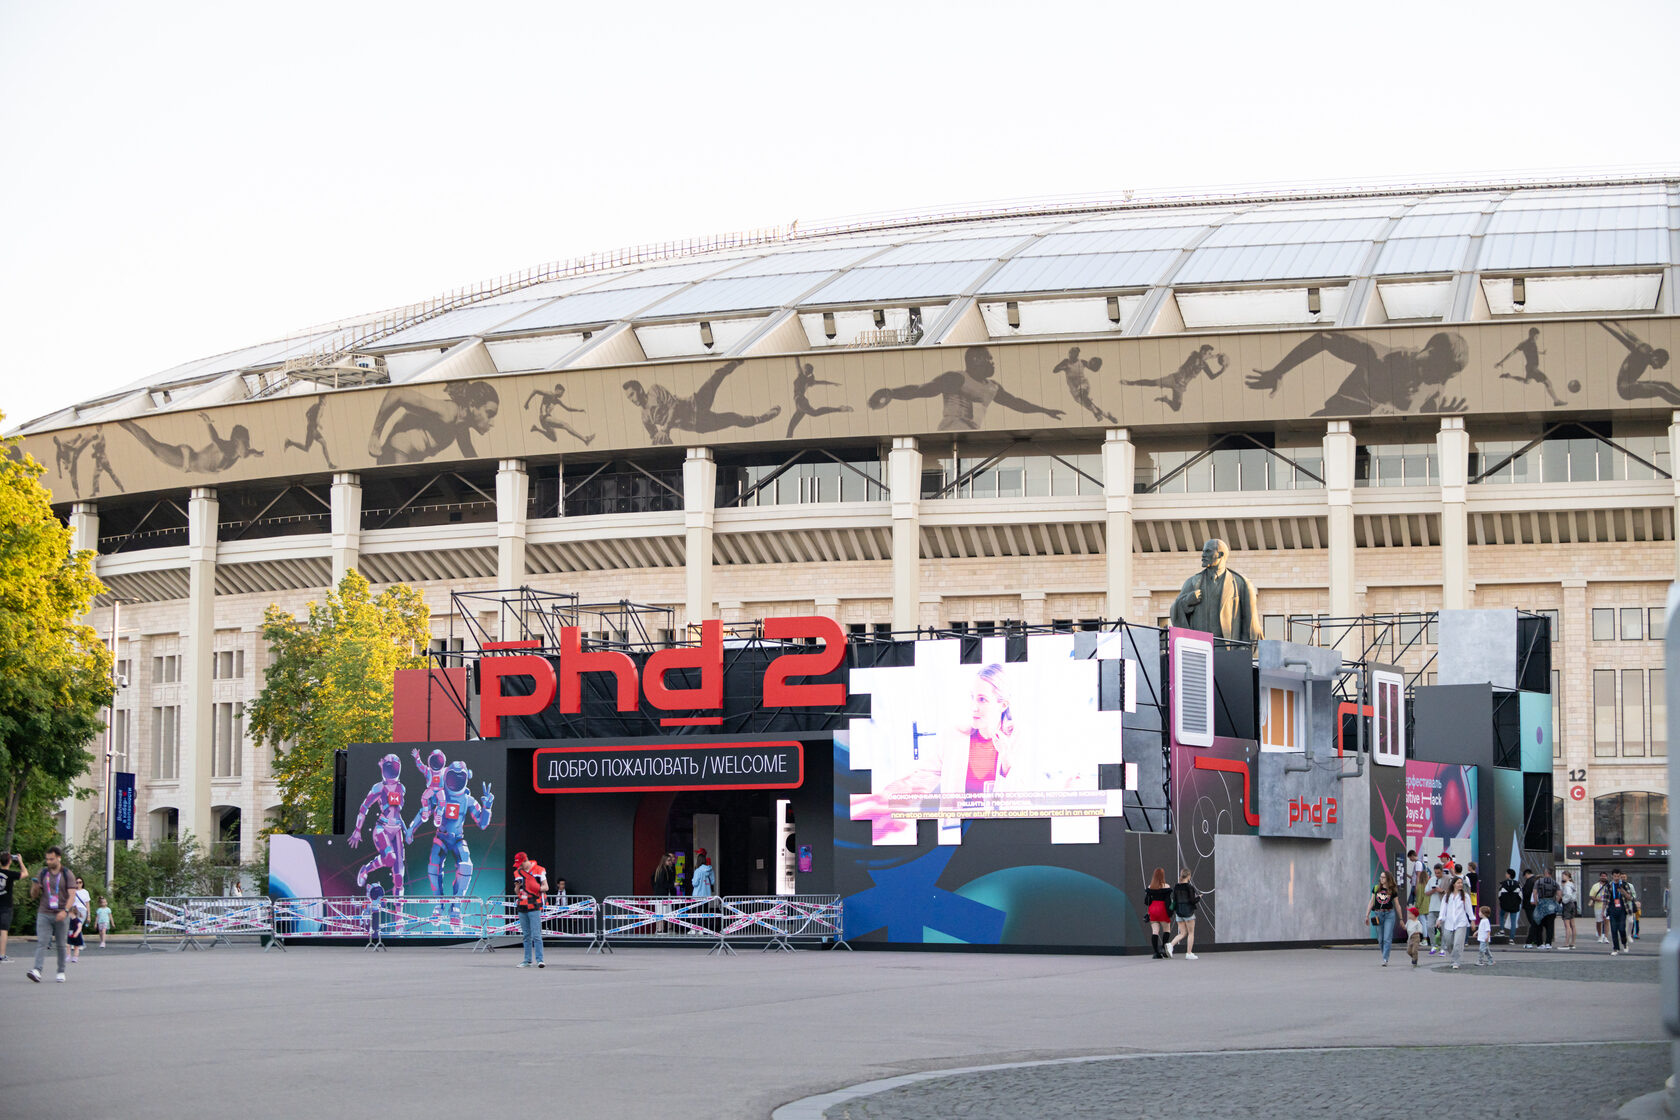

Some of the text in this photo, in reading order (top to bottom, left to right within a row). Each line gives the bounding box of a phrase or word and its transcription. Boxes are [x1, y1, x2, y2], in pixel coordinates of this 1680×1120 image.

[480, 616, 848, 737] phd 2
[548, 760, 598, 780] ДОБРО
[602, 756, 699, 776] ПОЖАЛОВАТЬ
[1568, 768, 1586, 782] 12
[1288, 795, 1337, 828] phd 2
[1420, 807, 1424, 820] 2
